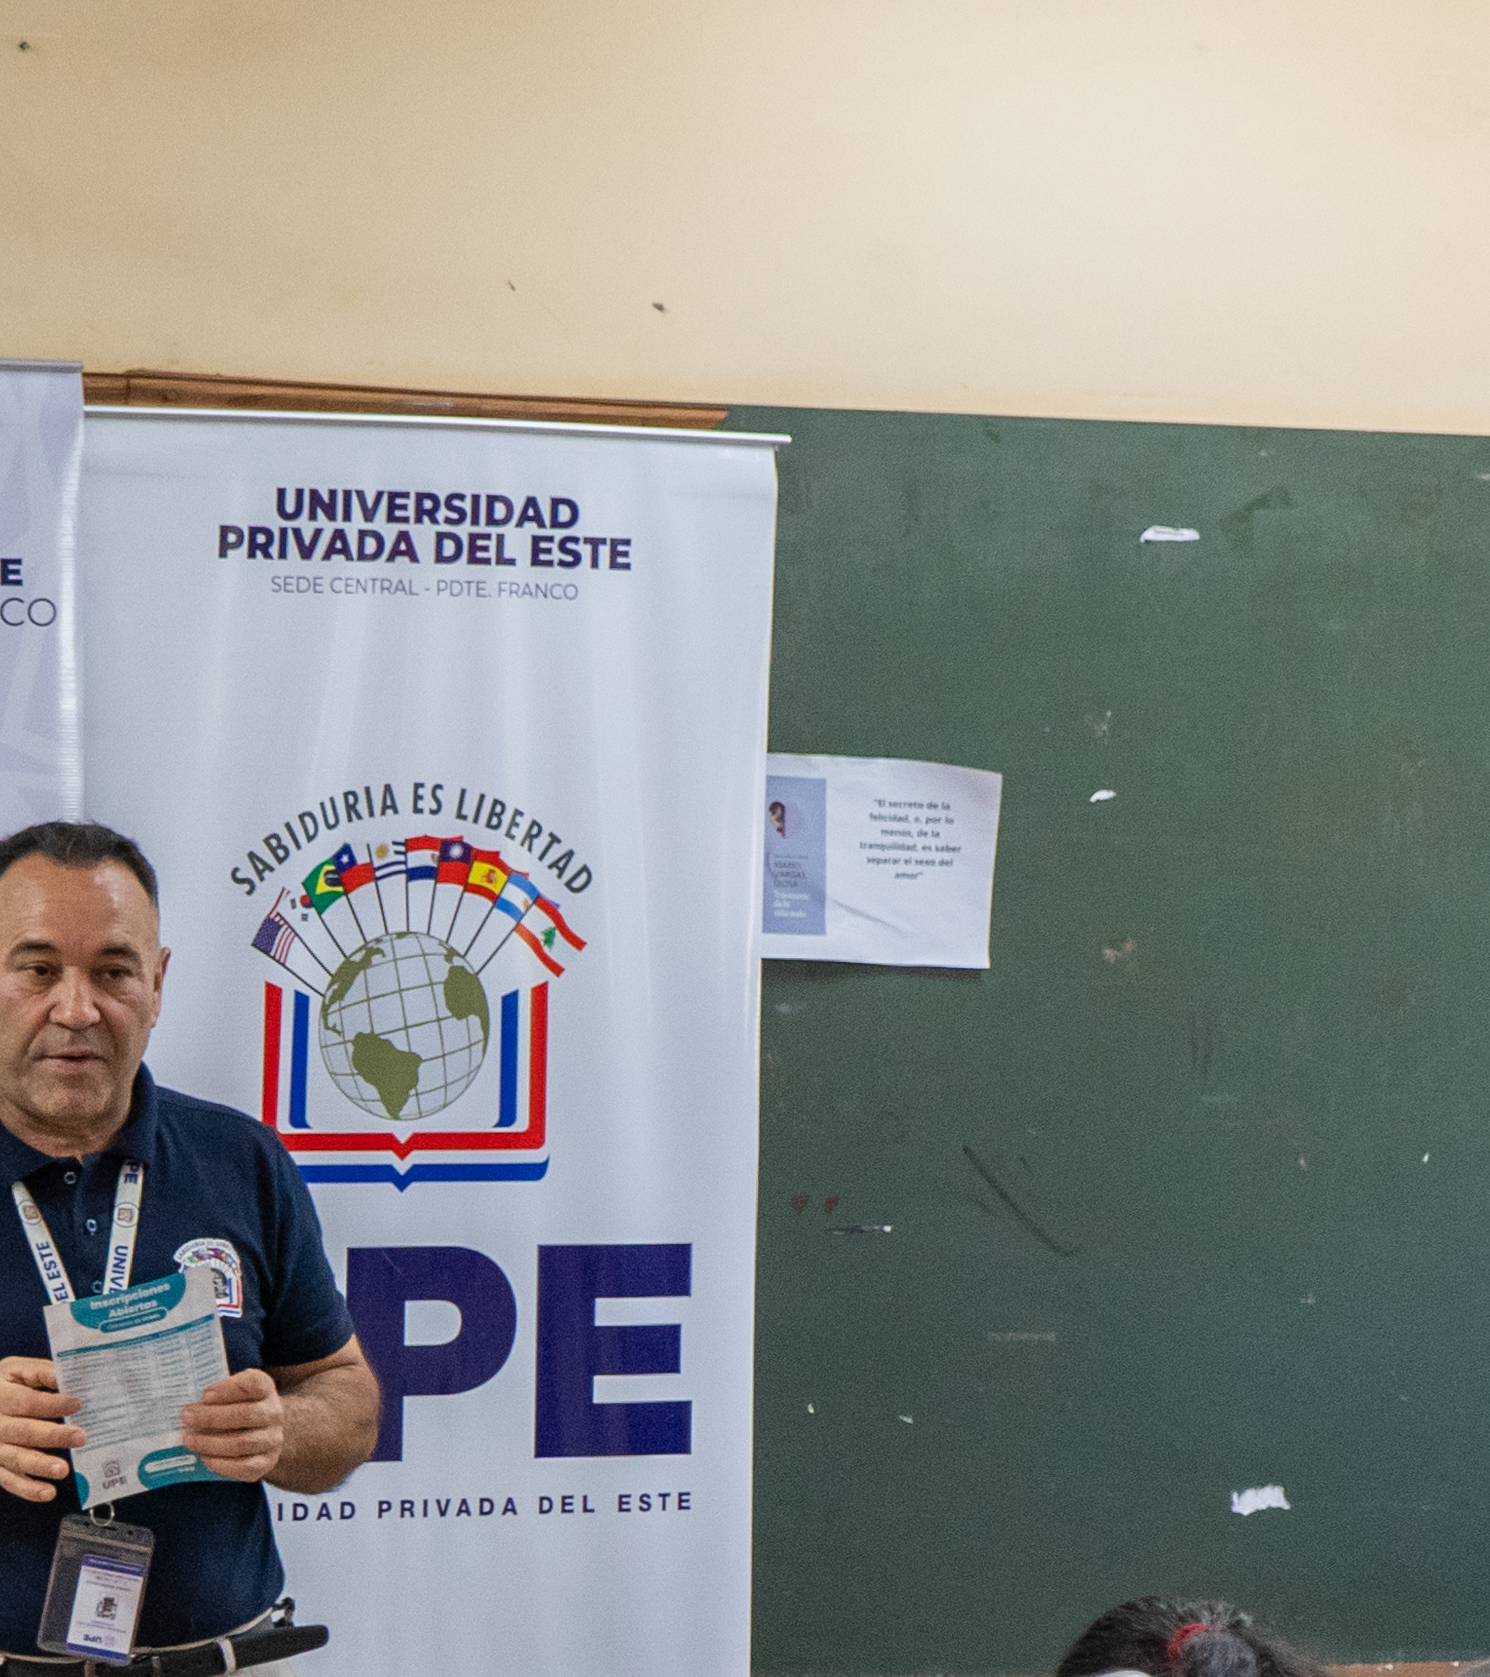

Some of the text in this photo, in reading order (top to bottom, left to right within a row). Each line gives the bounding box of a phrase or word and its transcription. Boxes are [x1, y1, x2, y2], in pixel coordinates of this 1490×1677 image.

[276, 487, 579, 530] UNIVERSIDAD
[218, 525, 632, 571] PRIVADA DEL ESTE
[270, 574, 579, 602] SEDE CENTRAL PDTE. FRANCO
[230, 782, 594, 896] SABIDURIA ES LIBERTAD
[35, 1240, 61, 1281] ESTE
[90, 1283, 171, 1310] Inscripciones
[108, 1300, 158, 1319] Abiertas
[346, 1243, 692, 1462] PE
[378, 1496, 518, 1520] PRIVADA
[538, 1494, 596, 1515] DEL
[617, 1491, 692, 1513] ESTE
